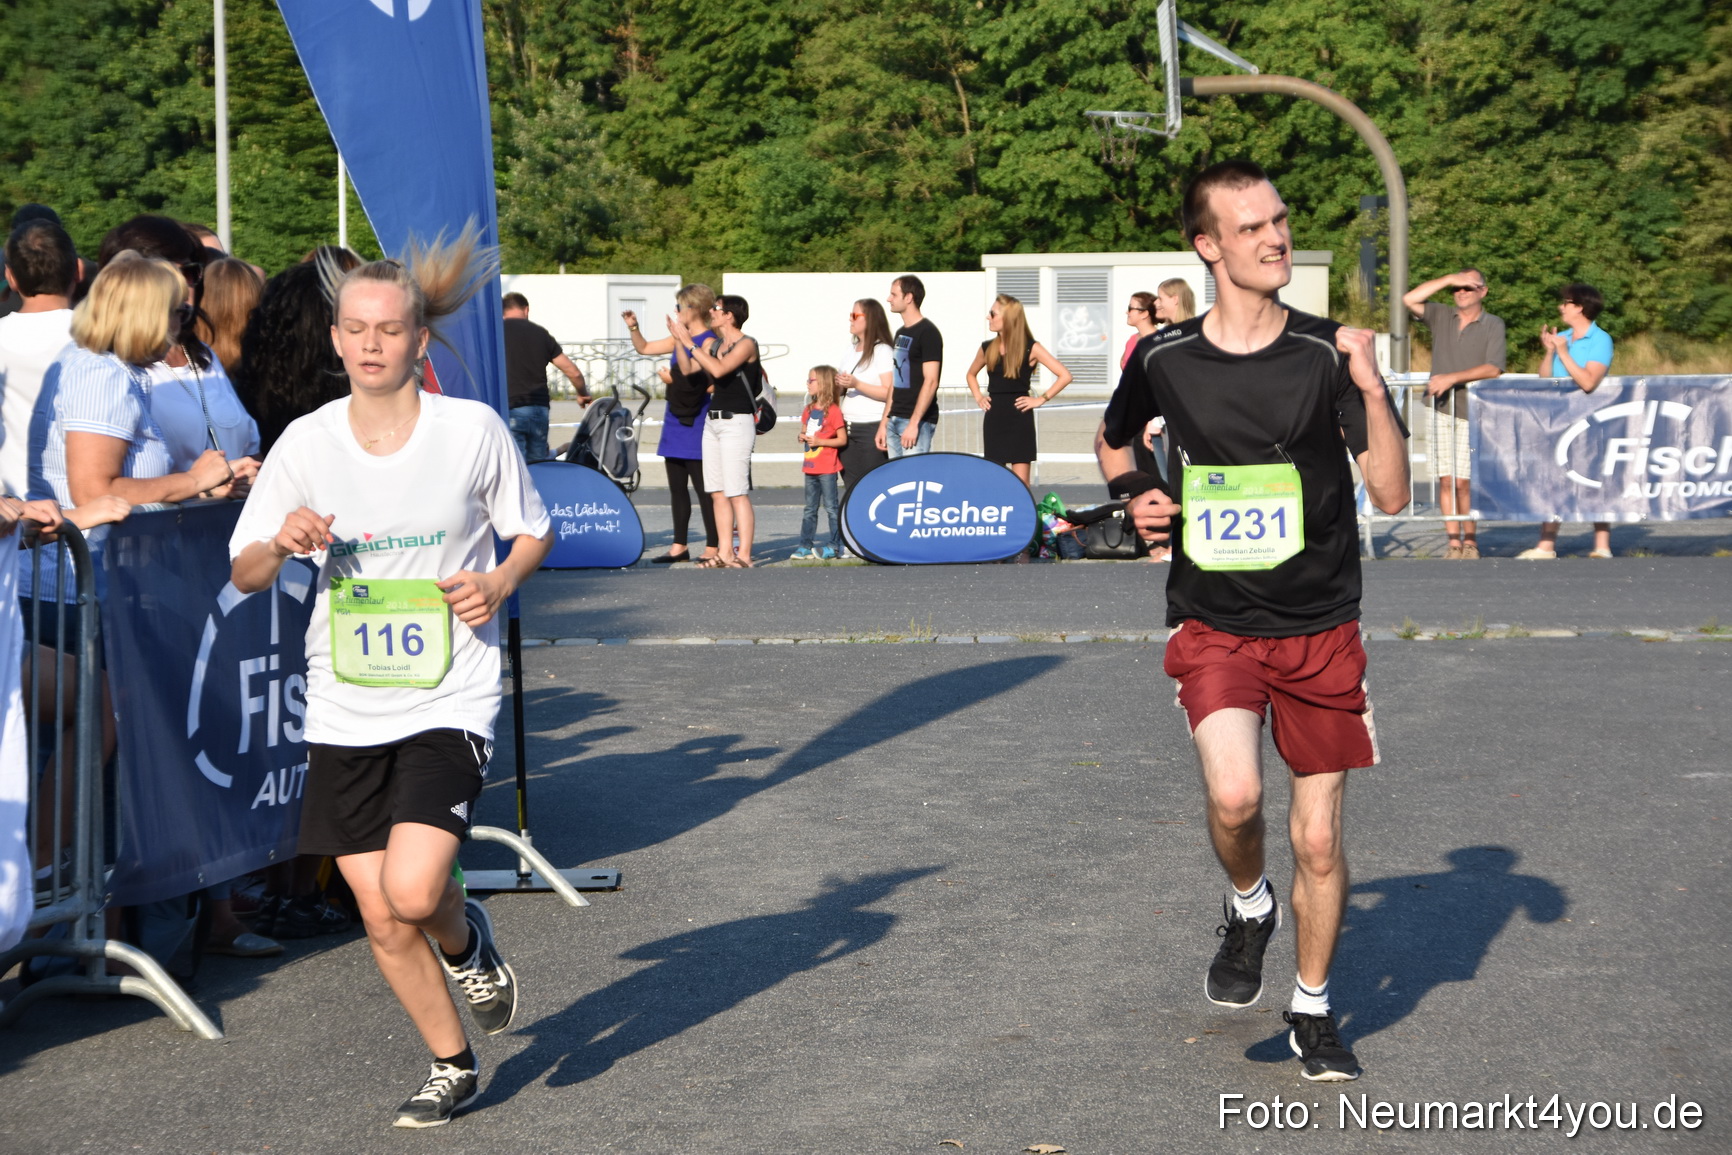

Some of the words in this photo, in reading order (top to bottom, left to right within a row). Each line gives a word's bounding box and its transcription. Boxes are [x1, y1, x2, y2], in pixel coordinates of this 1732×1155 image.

[1164, 329, 1182, 338] JAKO
[550, 502, 574, 518] das
[897, 500, 1014, 526] Fischer
[559, 520, 592, 541] fährt
[594, 520, 620, 533] mit!
[909, 525, 1007, 539] AUTOMOBILE
[1197, 506, 1287, 541] 1231
[328, 530, 447, 558] Gleichauf
[354, 622, 425, 656] 116
[251, 762, 310, 810] AUT
